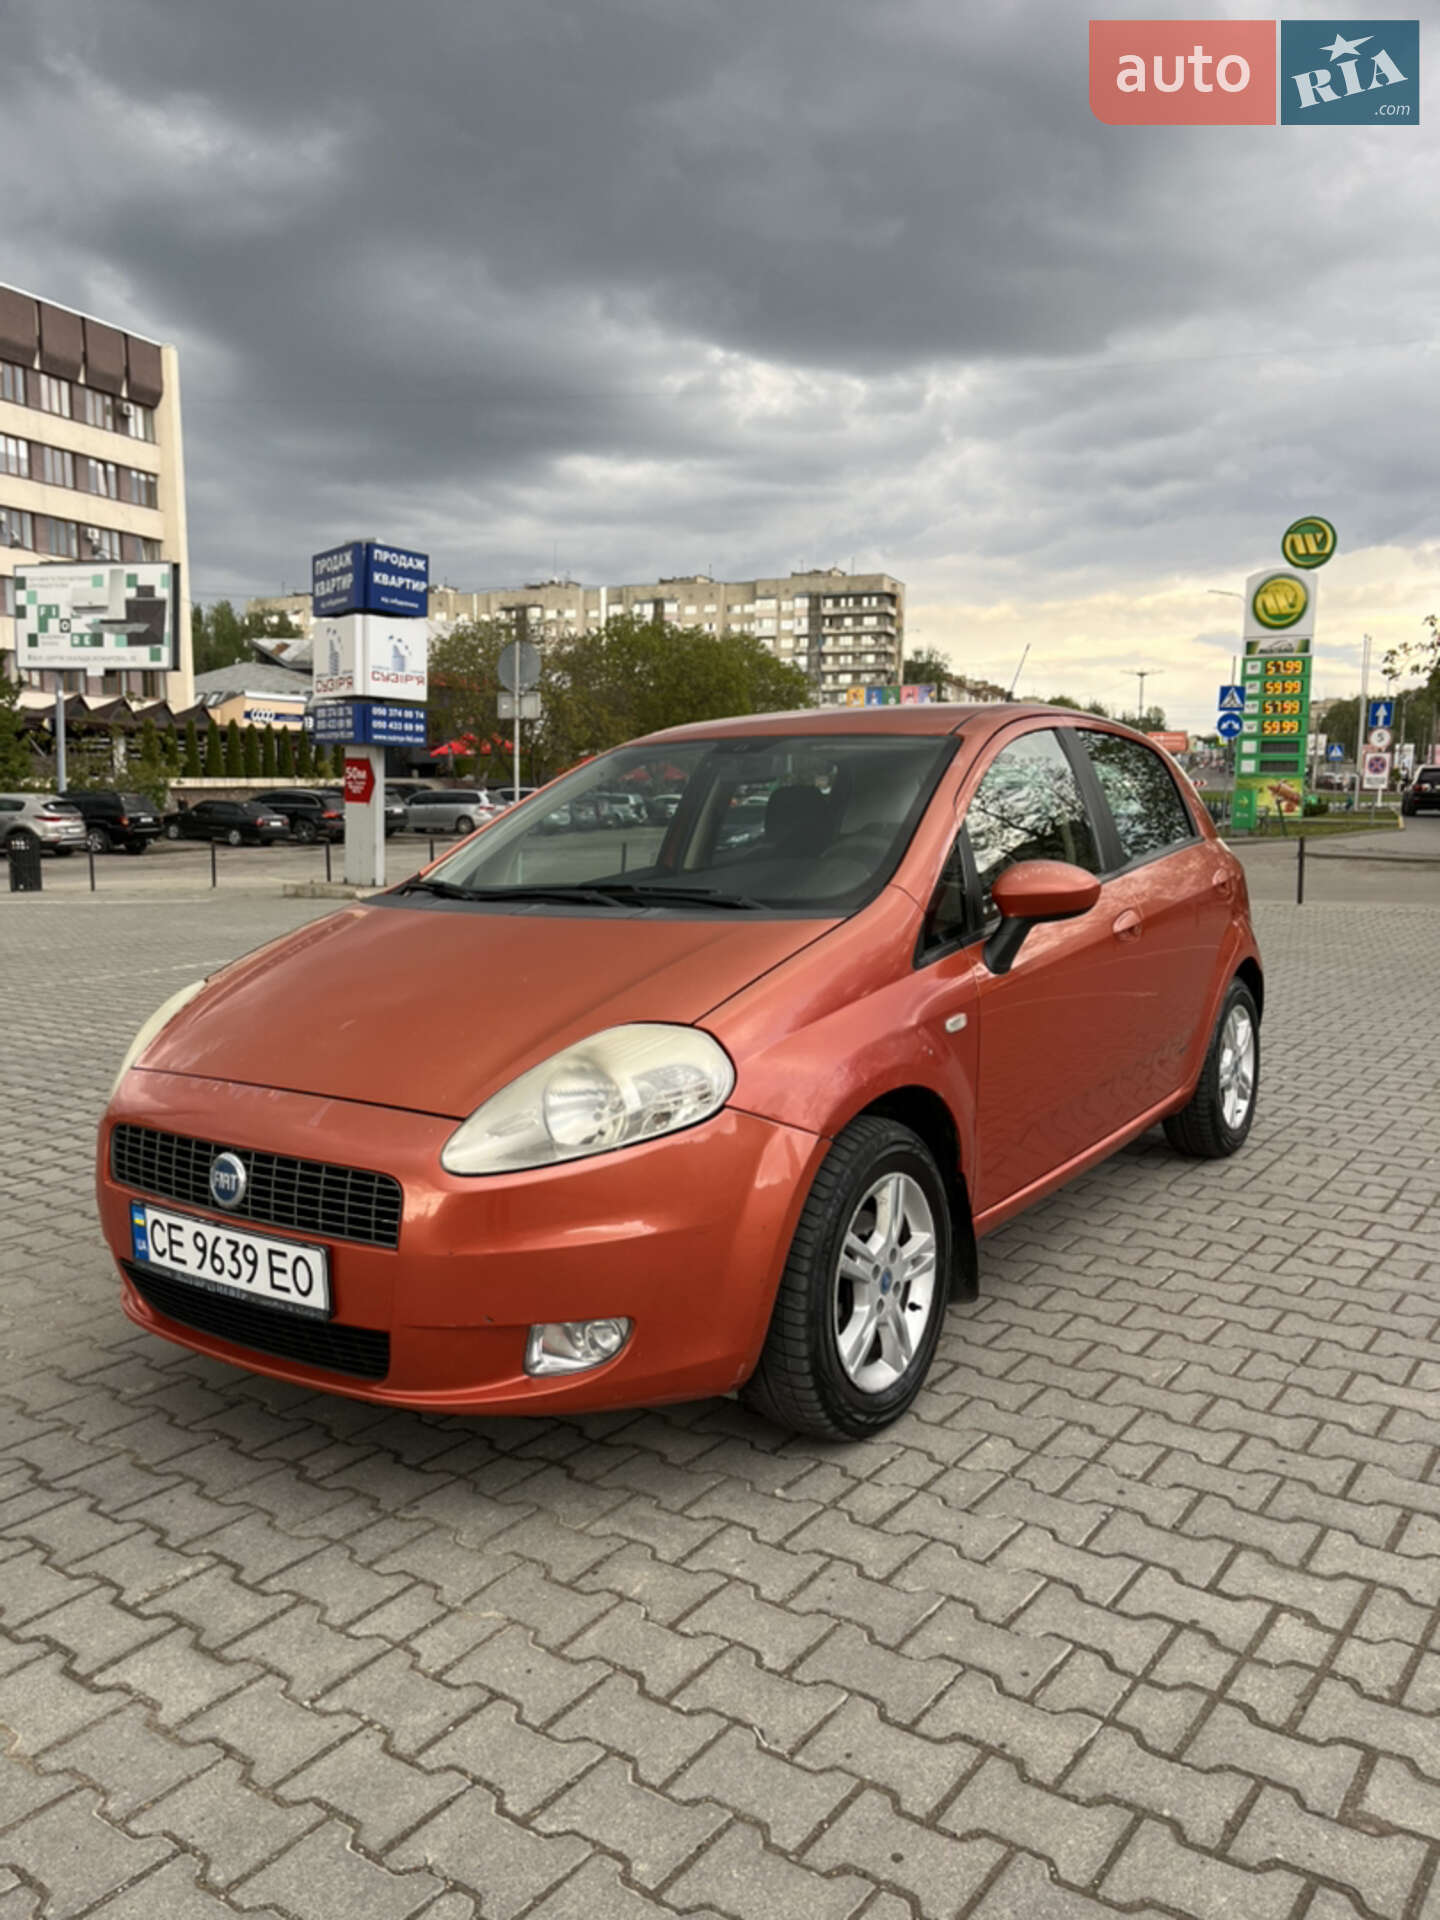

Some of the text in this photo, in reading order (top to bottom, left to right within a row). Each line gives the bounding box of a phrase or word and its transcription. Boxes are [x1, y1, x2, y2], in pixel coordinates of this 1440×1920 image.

[315, 550, 353, 576] ПРОДАЖ
[373, 548, 426, 571] ПРОДАЖ
[373, 571, 428, 592] КВАРТИР
[214, 1170, 239, 1192] FIAT
[150, 1218, 187, 1266] CE
[192, 1230, 259, 1285] 9639
[267, 1247, 314, 1298] EO
